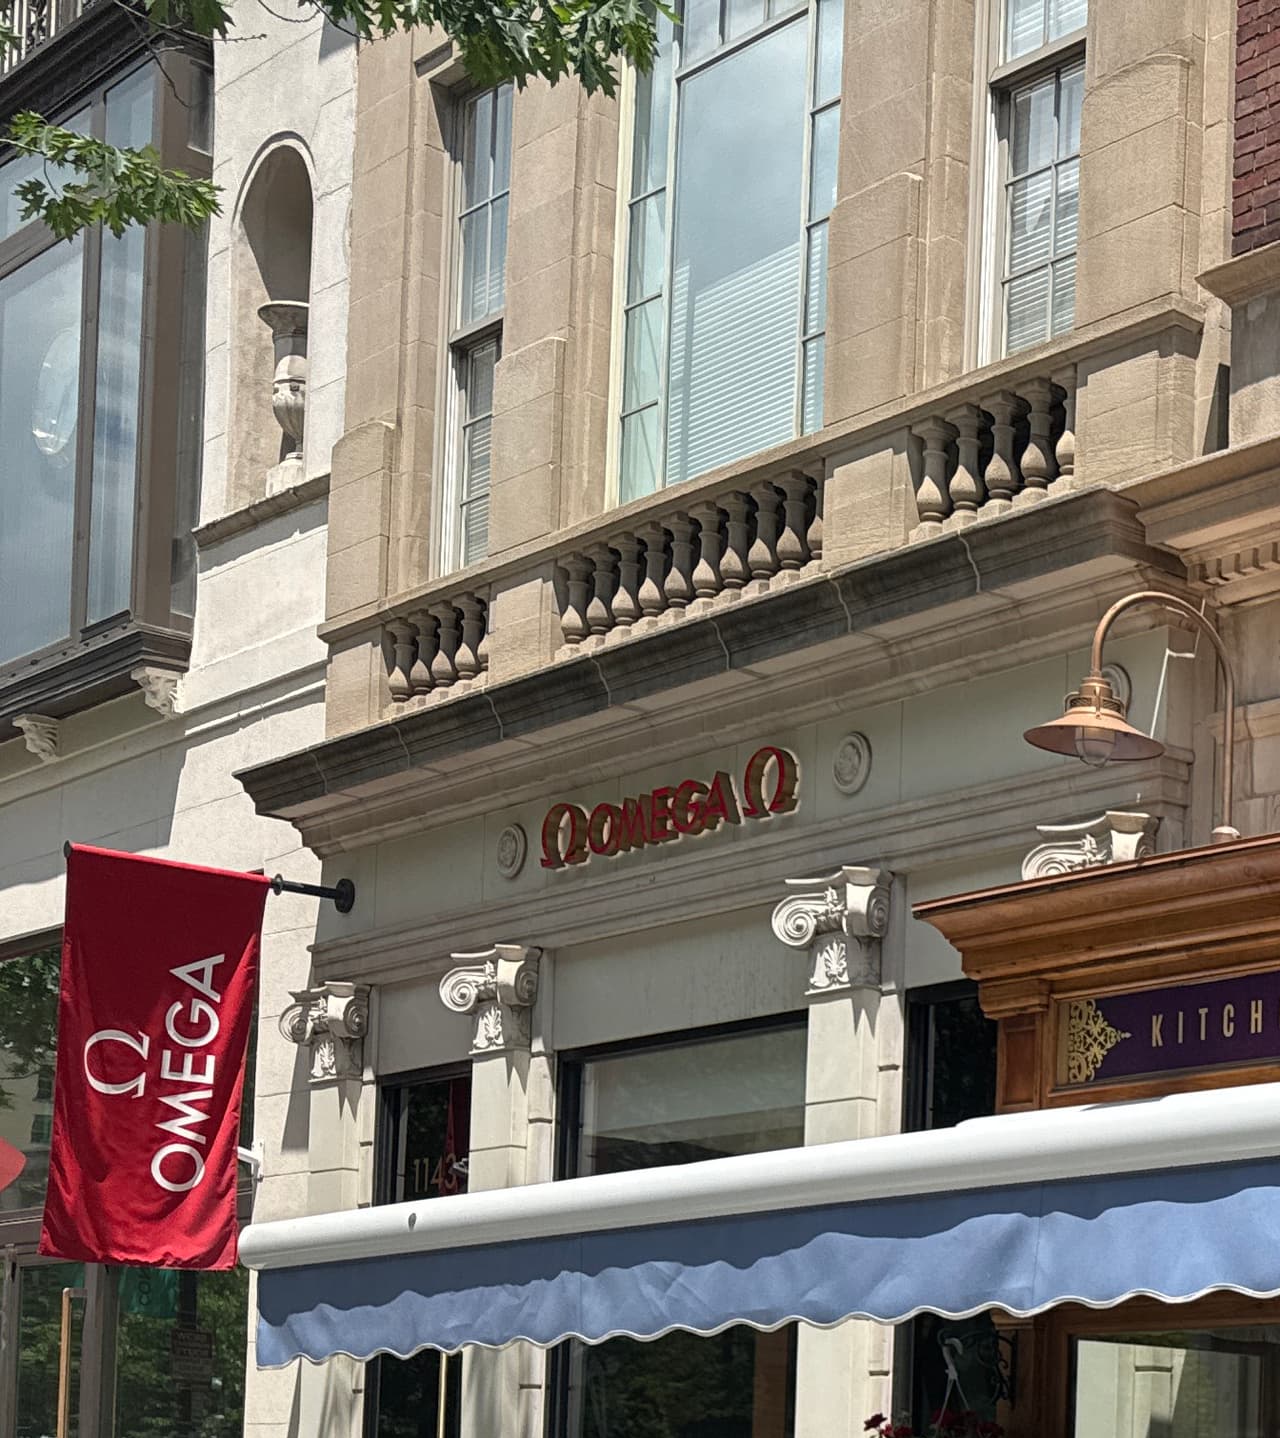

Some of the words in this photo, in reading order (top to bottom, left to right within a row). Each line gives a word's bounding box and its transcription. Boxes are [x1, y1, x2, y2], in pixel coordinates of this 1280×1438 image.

[587, 771, 742, 856] OMEGA
[150, 953, 226, 1193] OMEGA
[413, 1152, 458, 1193] 1143
